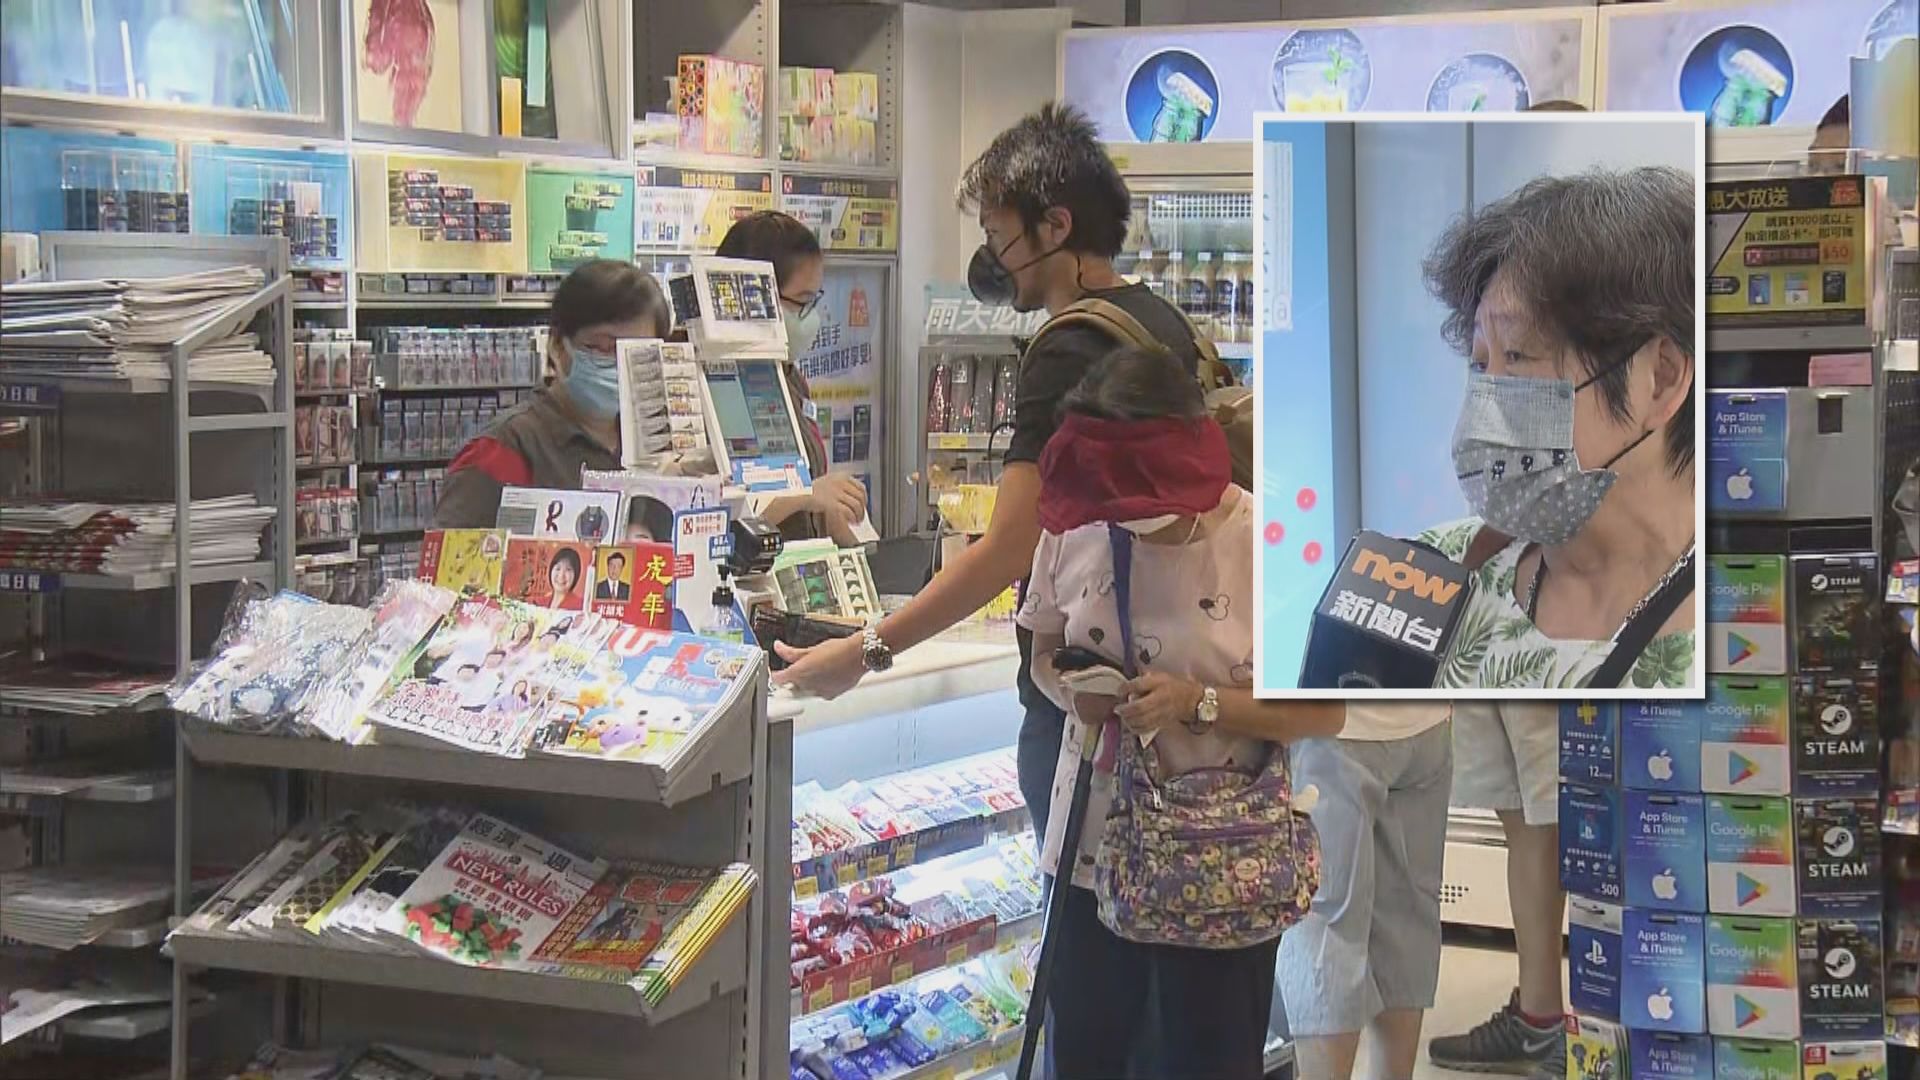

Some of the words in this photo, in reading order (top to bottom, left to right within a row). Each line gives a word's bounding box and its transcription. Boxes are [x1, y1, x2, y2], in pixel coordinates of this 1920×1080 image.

[1715, 412, 1737, 422] App
[1738, 412, 1767, 422] Store
[1718, 424, 1727, 434] &
[1729, 424, 1763, 434] iTunes
[1351, 548, 1462, 605] now
[1829, 577, 1861, 586] STEAM
[639, 554, 673, 628] 虎年
[1328, 589, 1443, 652] 新聞台
[1705, 702, 1752, 718] Google
[1805, 740, 1865, 756] STEAM
[1589, 765, 1600, 778] 12
[1639, 811, 1660, 823] App
[1661, 812, 1688, 824] Store
[1643, 824, 1651, 833] &
[1653, 824, 1685, 835] iTunes
[1710, 821, 1757, 839] Google
[1808, 862, 1868, 878] STEAM
[453, 855, 502, 885] NEW
[502, 878, 563, 916] RULES
[1601, 883, 1620, 896] 500
[1638, 930, 1659, 942] App
[1660, 931, 1688, 943] Store
[1640, 943, 1649, 953] &
[1651, 944, 1684, 955] iTunes
[1709, 943, 1756, 961] Google
[1809, 983, 1869, 999] STEAM
[1648, 1048, 1670, 1060] App
[1671, 1050, 1697, 1062] Store
[1651, 1061, 1660, 1071] &
